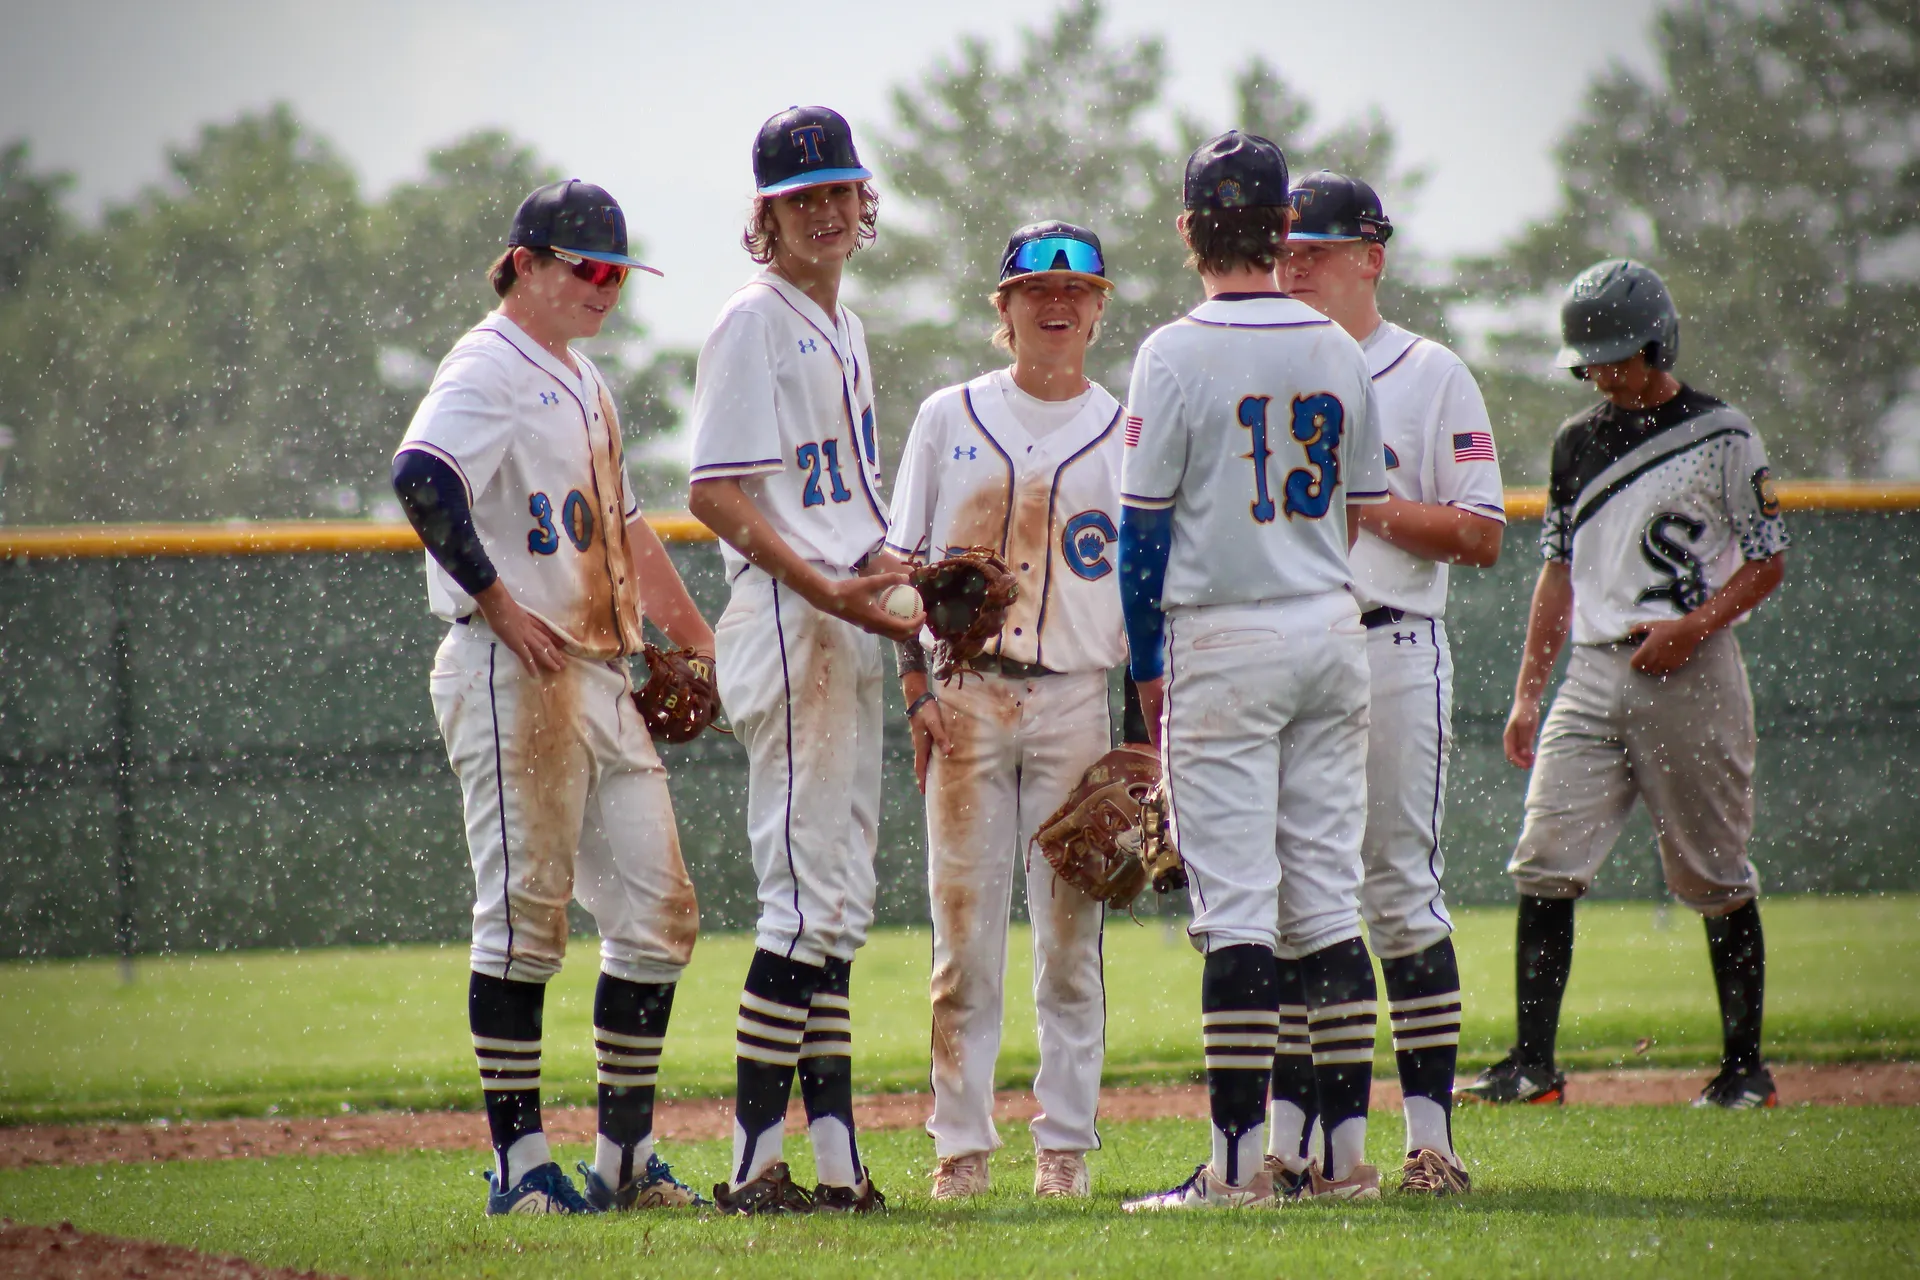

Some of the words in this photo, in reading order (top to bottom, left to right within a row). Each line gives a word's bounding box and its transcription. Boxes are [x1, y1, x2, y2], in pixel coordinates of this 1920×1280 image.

[790, 125, 826, 164] T
[1288, 188, 1316, 224] T
[796, 437, 852, 509] 21
[1232, 391, 1346, 525] 13
[527, 489, 595, 557] 30
[1061, 509, 1119, 582] C
